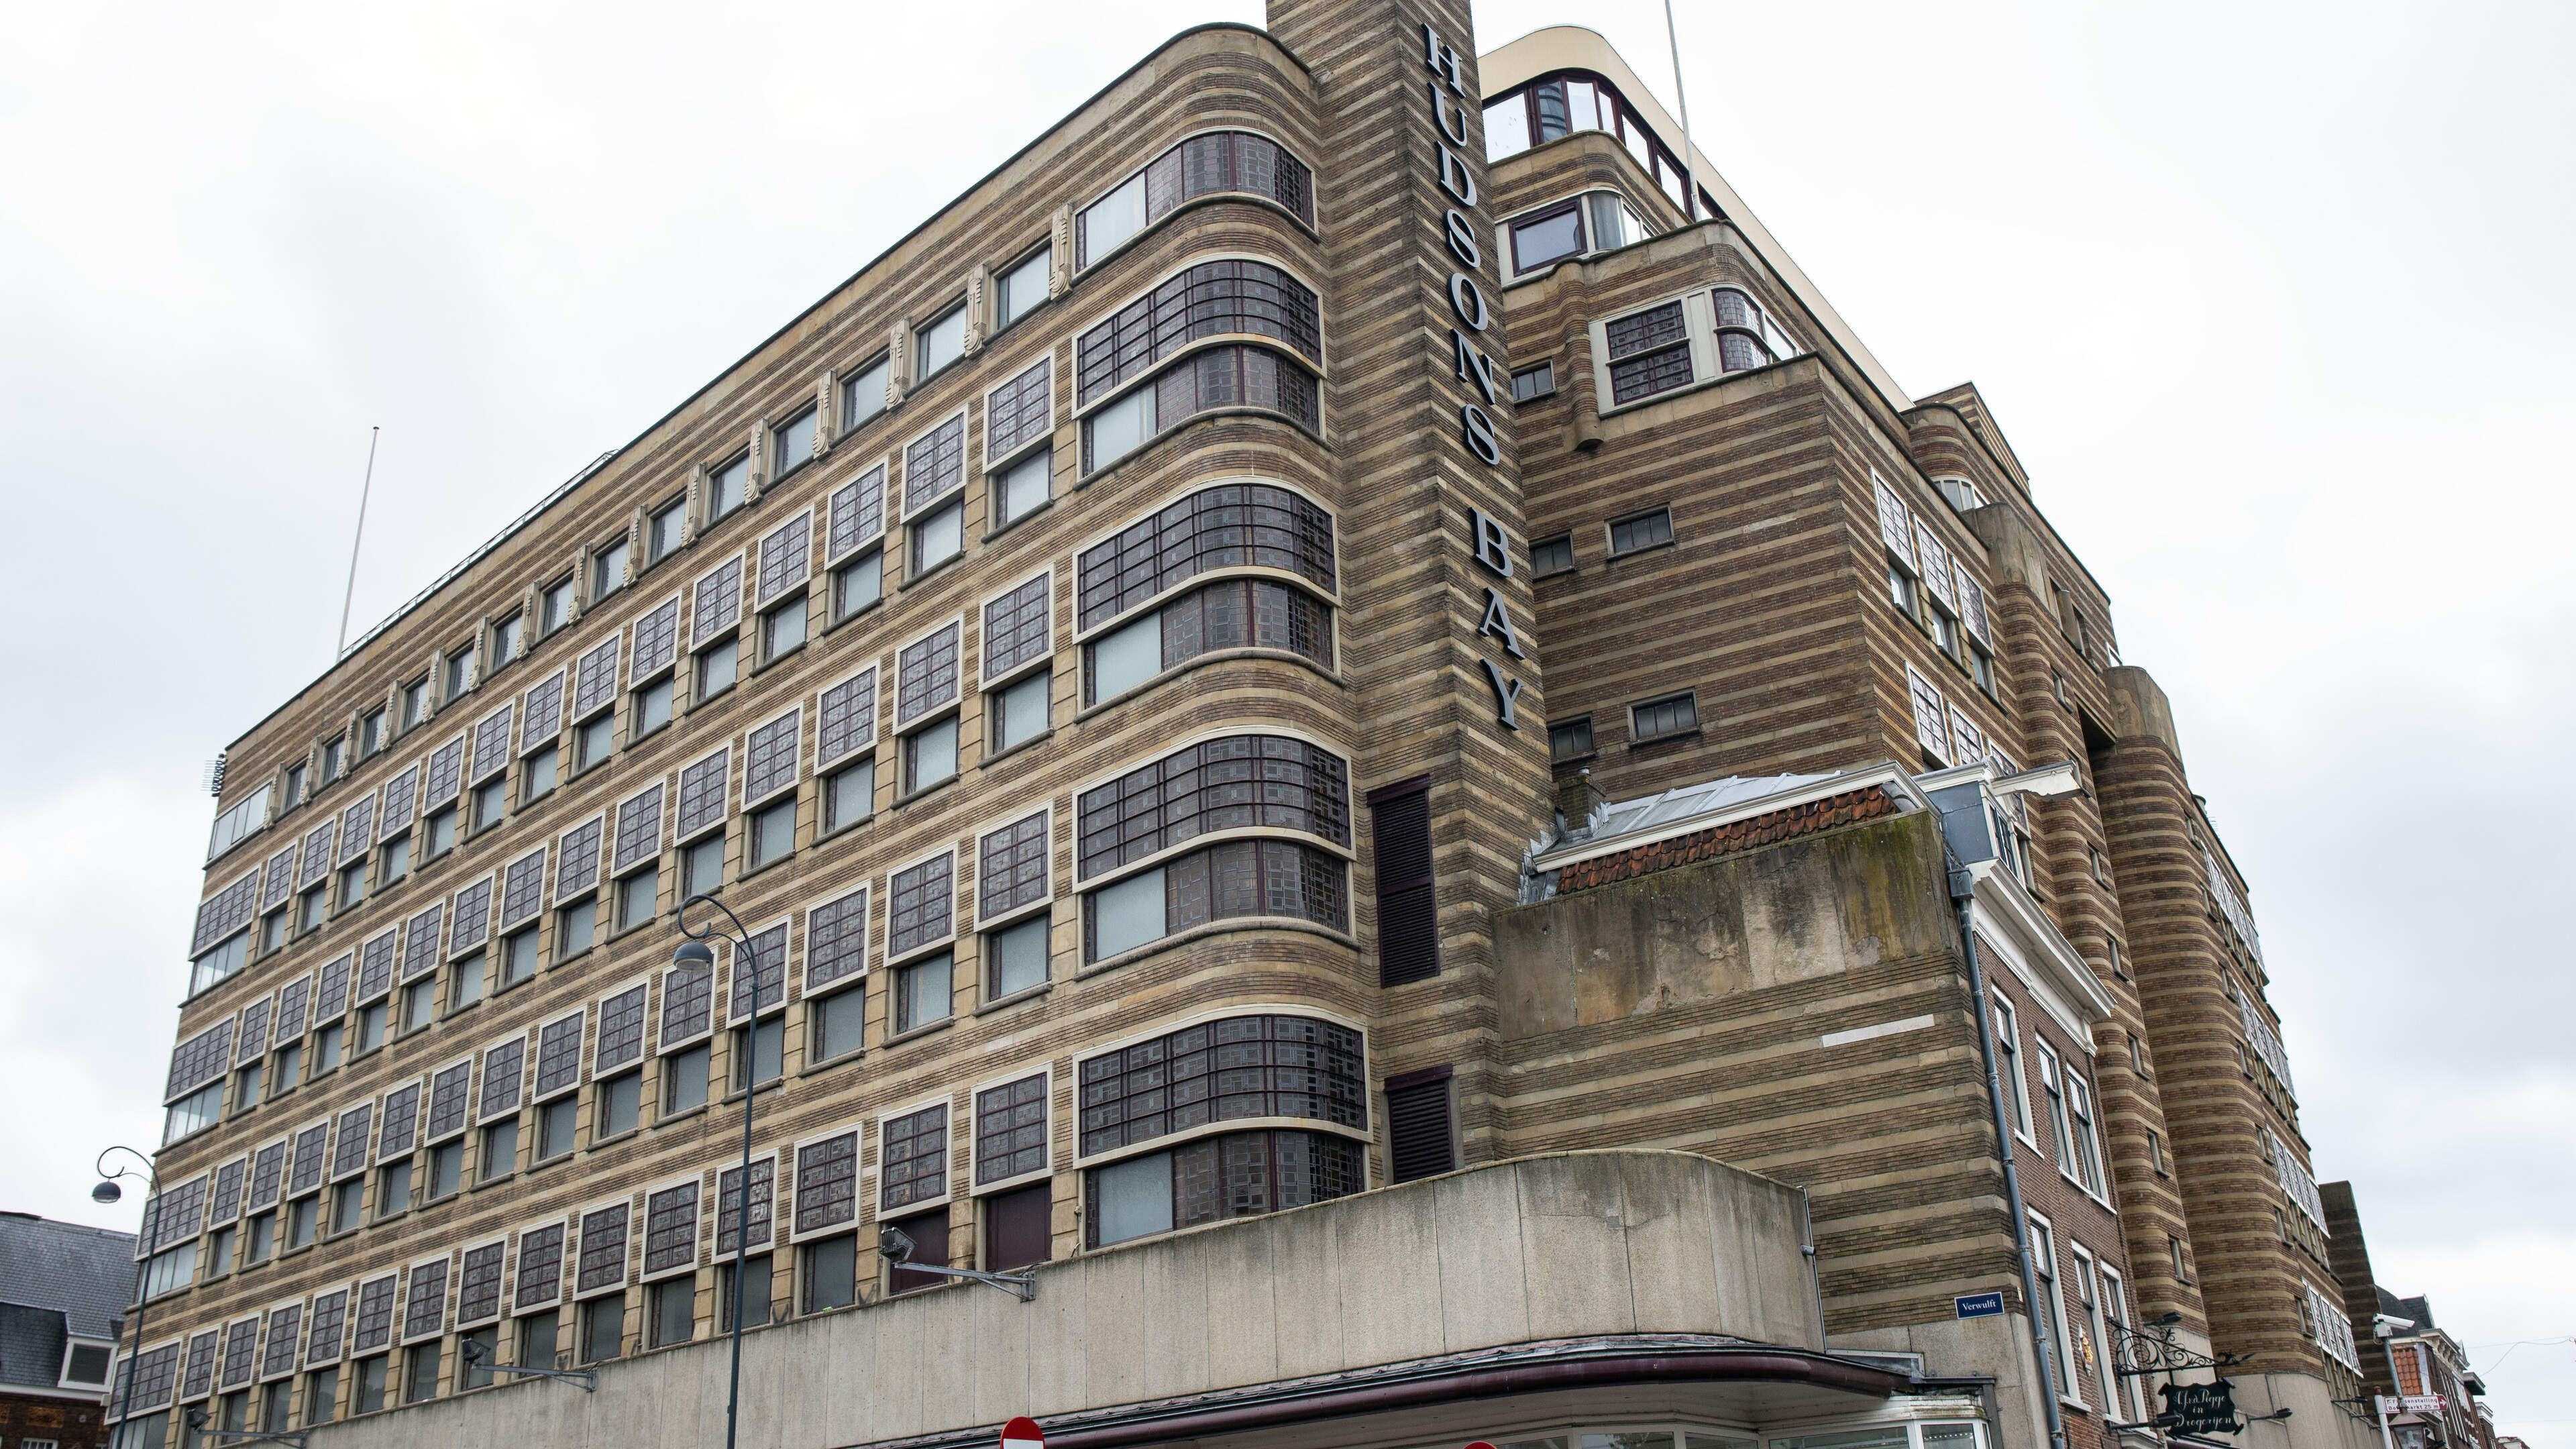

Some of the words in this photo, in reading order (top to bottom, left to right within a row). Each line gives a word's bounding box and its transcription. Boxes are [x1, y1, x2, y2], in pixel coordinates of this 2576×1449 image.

[1421, 22, 1501, 466] HUDSONS
[1468, 506, 1526, 731] BAY
[1962, 1299, 1996, 1311] Verwulft
